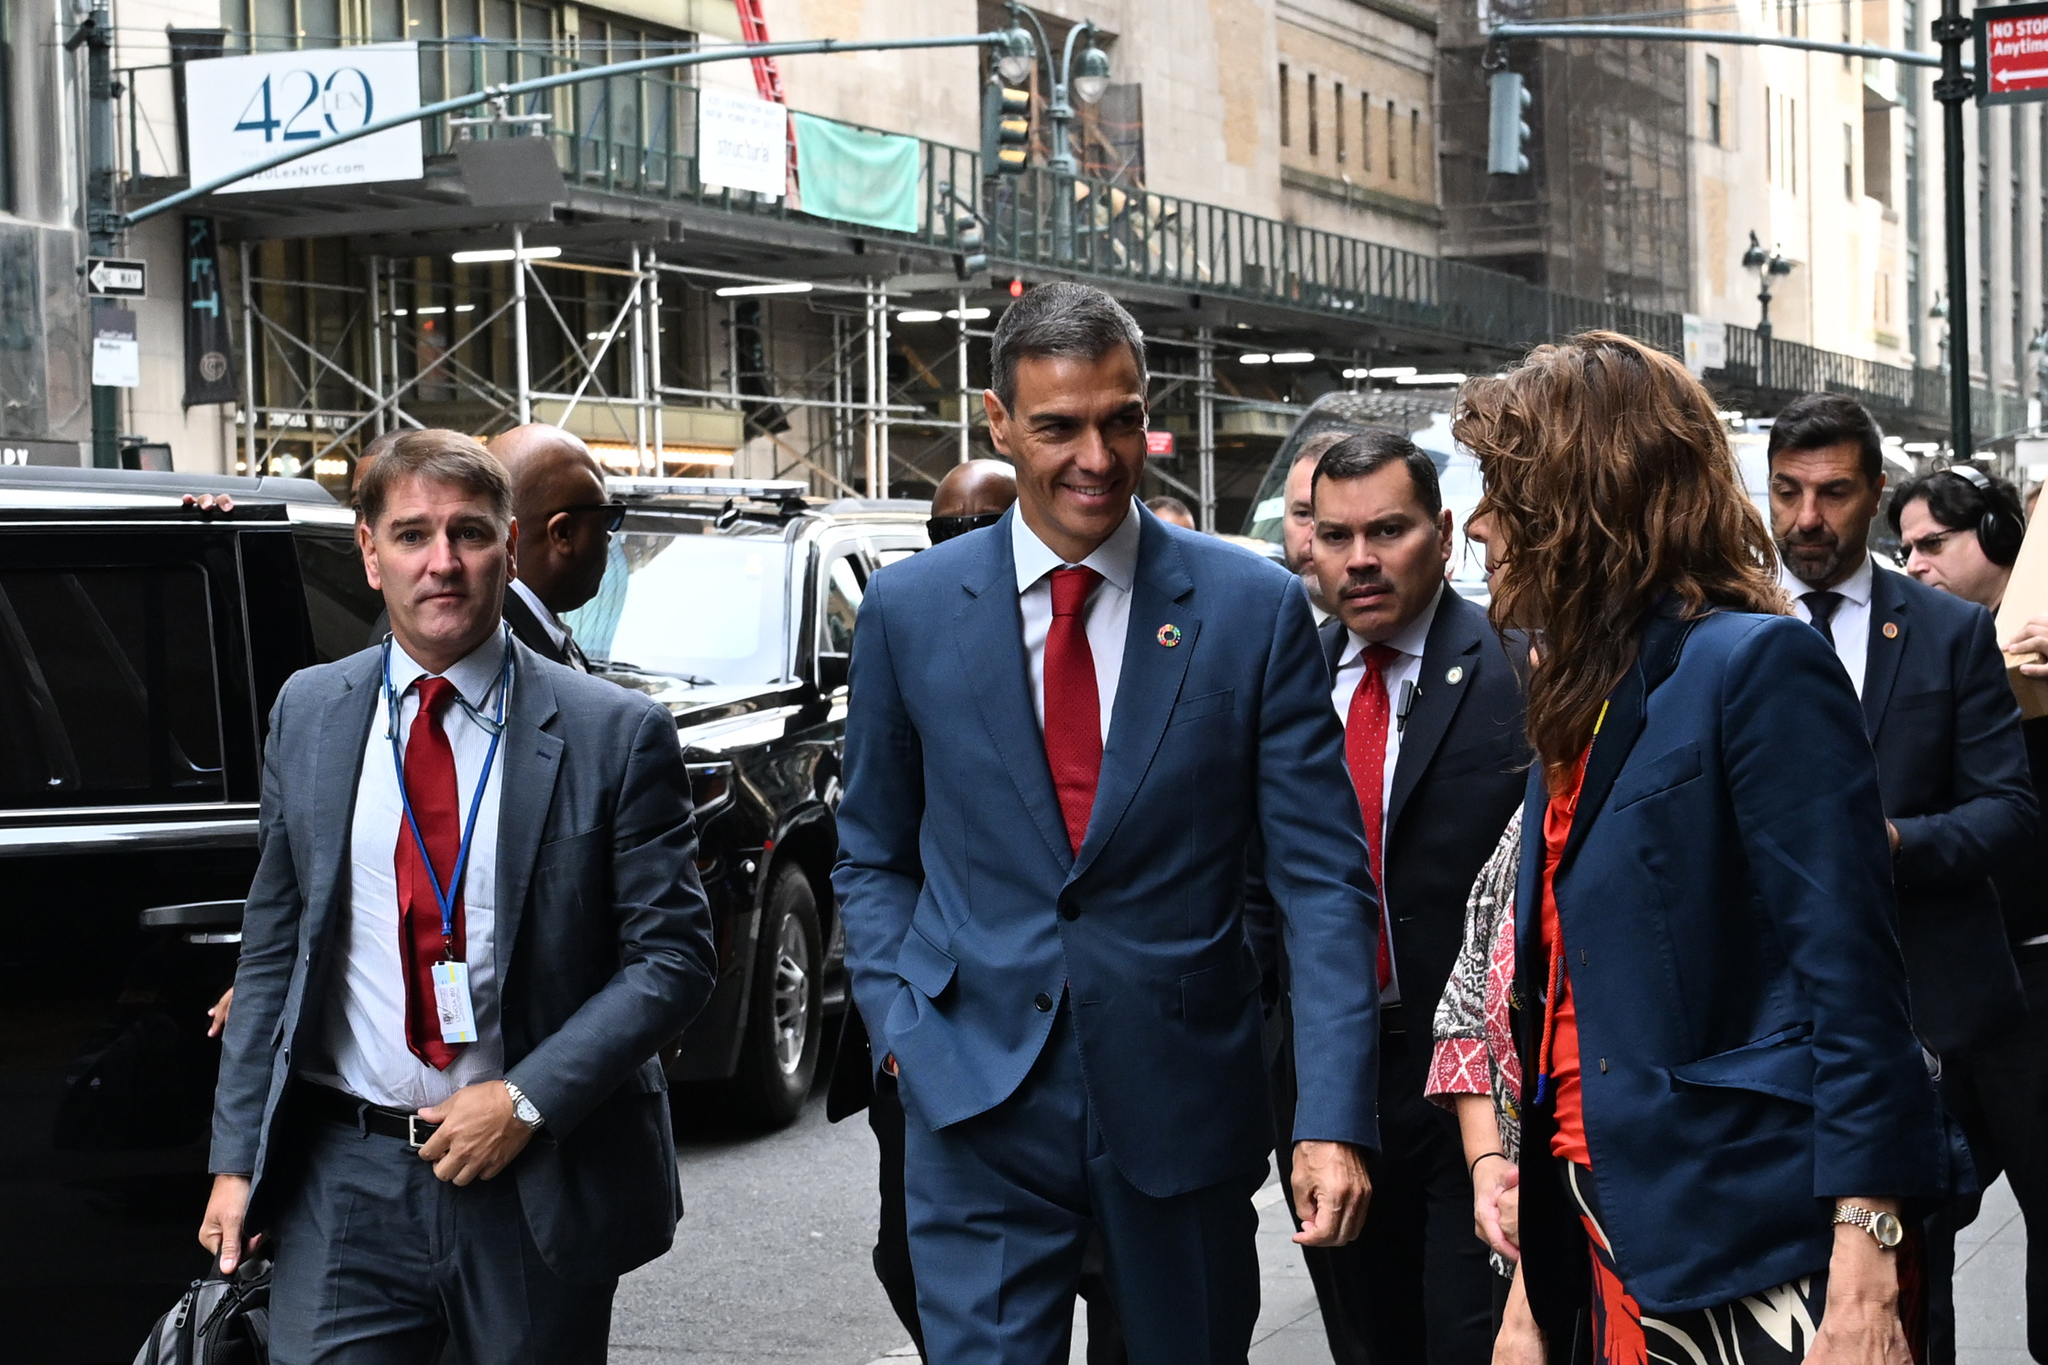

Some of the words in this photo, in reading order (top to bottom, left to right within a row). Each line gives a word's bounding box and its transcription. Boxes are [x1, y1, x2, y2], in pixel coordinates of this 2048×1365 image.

[1993, 22, 2013, 38] NO
[234, 66, 373, 142] 420
[322, 91, 364, 112] LEX
[120, 271, 139, 286] WAY
[0, 447, 29, 467] DY
